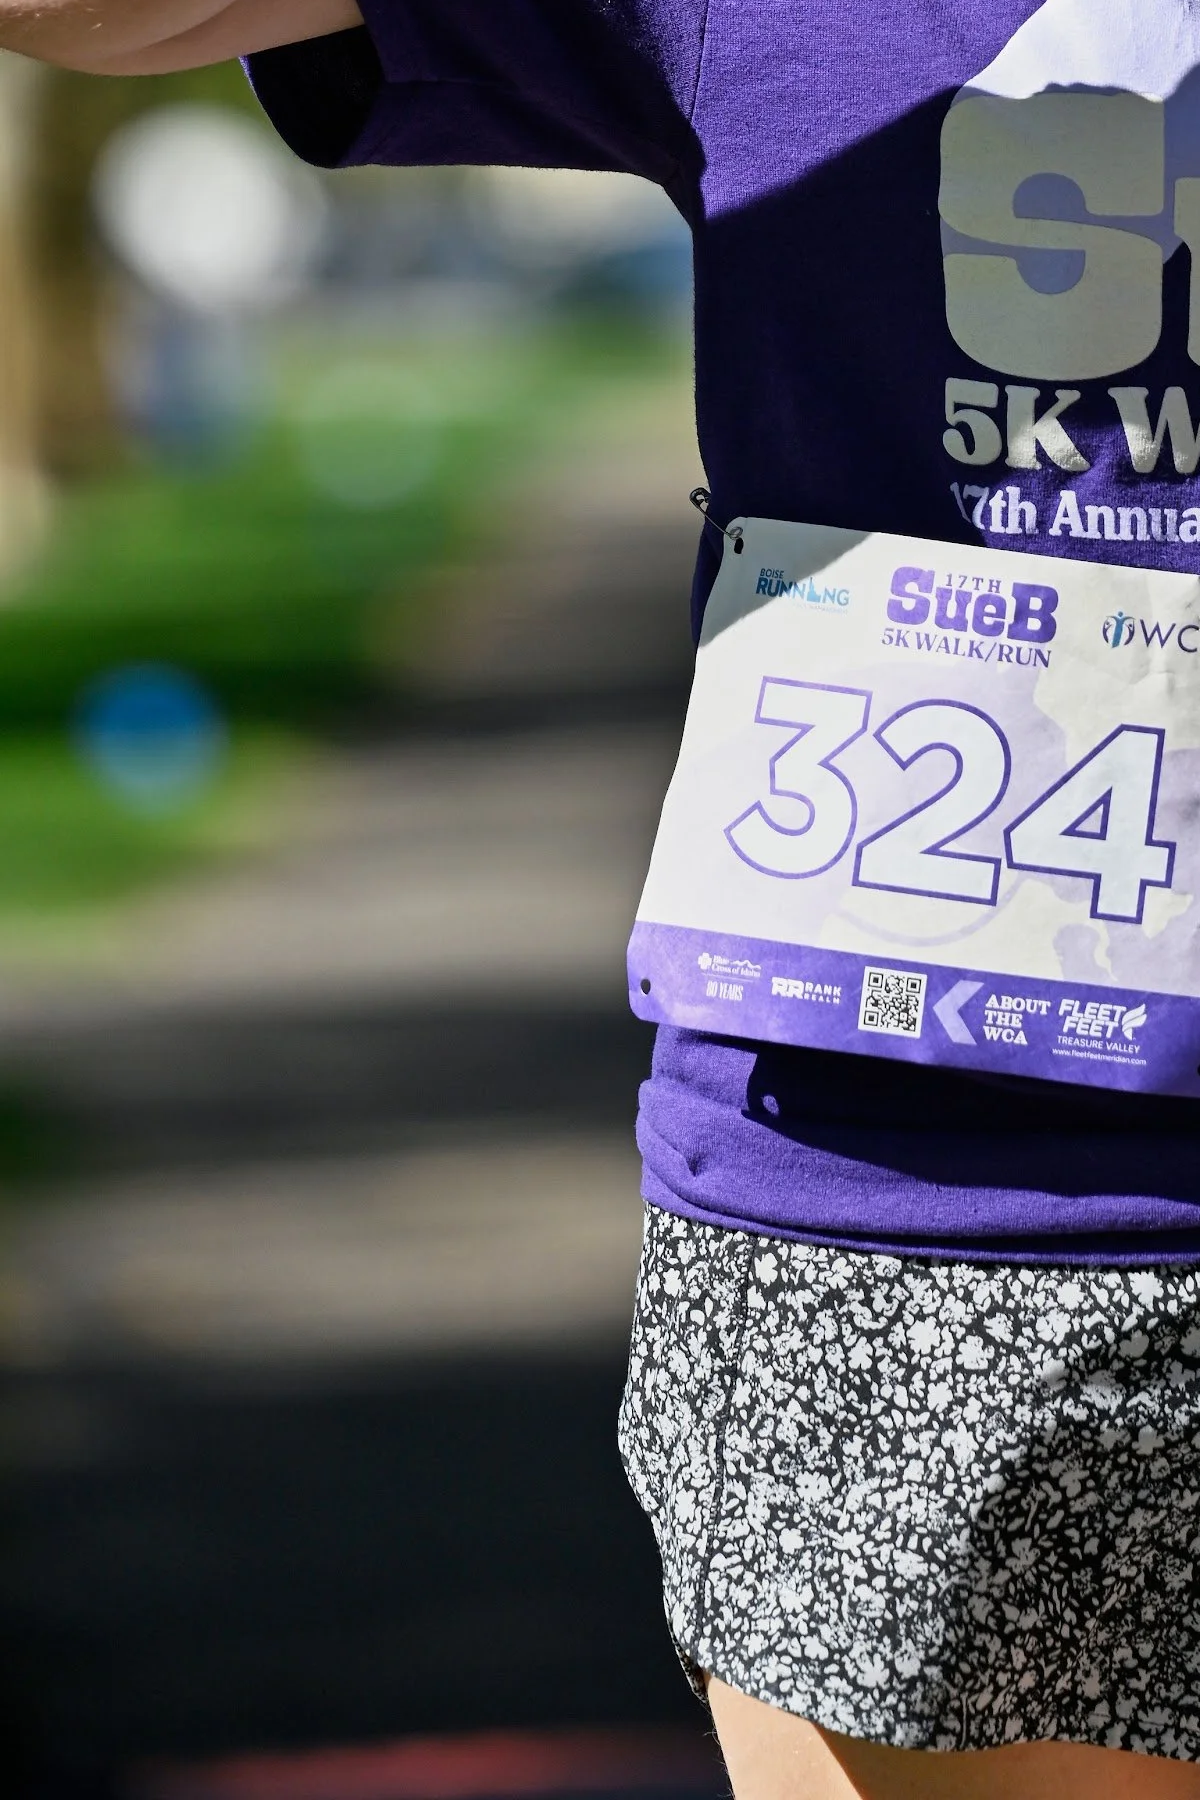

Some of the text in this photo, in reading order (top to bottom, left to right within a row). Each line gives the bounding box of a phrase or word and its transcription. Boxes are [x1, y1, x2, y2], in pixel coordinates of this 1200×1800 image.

[943, 377, 1090, 472] 5K
[950, 482, 1039, 534] 17th
[760, 568, 784, 578] BOISE
[946, 574, 1001, 593] 17TH
[887, 566, 1059, 643] SueB
[882, 628, 1052, 668] 5K WALK/RUN
[724, 676, 1177, 924] 324
[719, 982, 744, 1001] YEARS
[804, 993, 840, 1005] REALM
[805, 982, 841, 996] RANK
[985, 994, 1051, 1015] ABOUT
[1058, 999, 1126, 1022] FLEET
[984, 1009, 1023, 1028] THE
[1062, 1016, 1119, 1039] FEET
[983, 1026, 1028, 1045] WCA
[1057, 1035, 1141, 1054] TREASURE VALLEY
